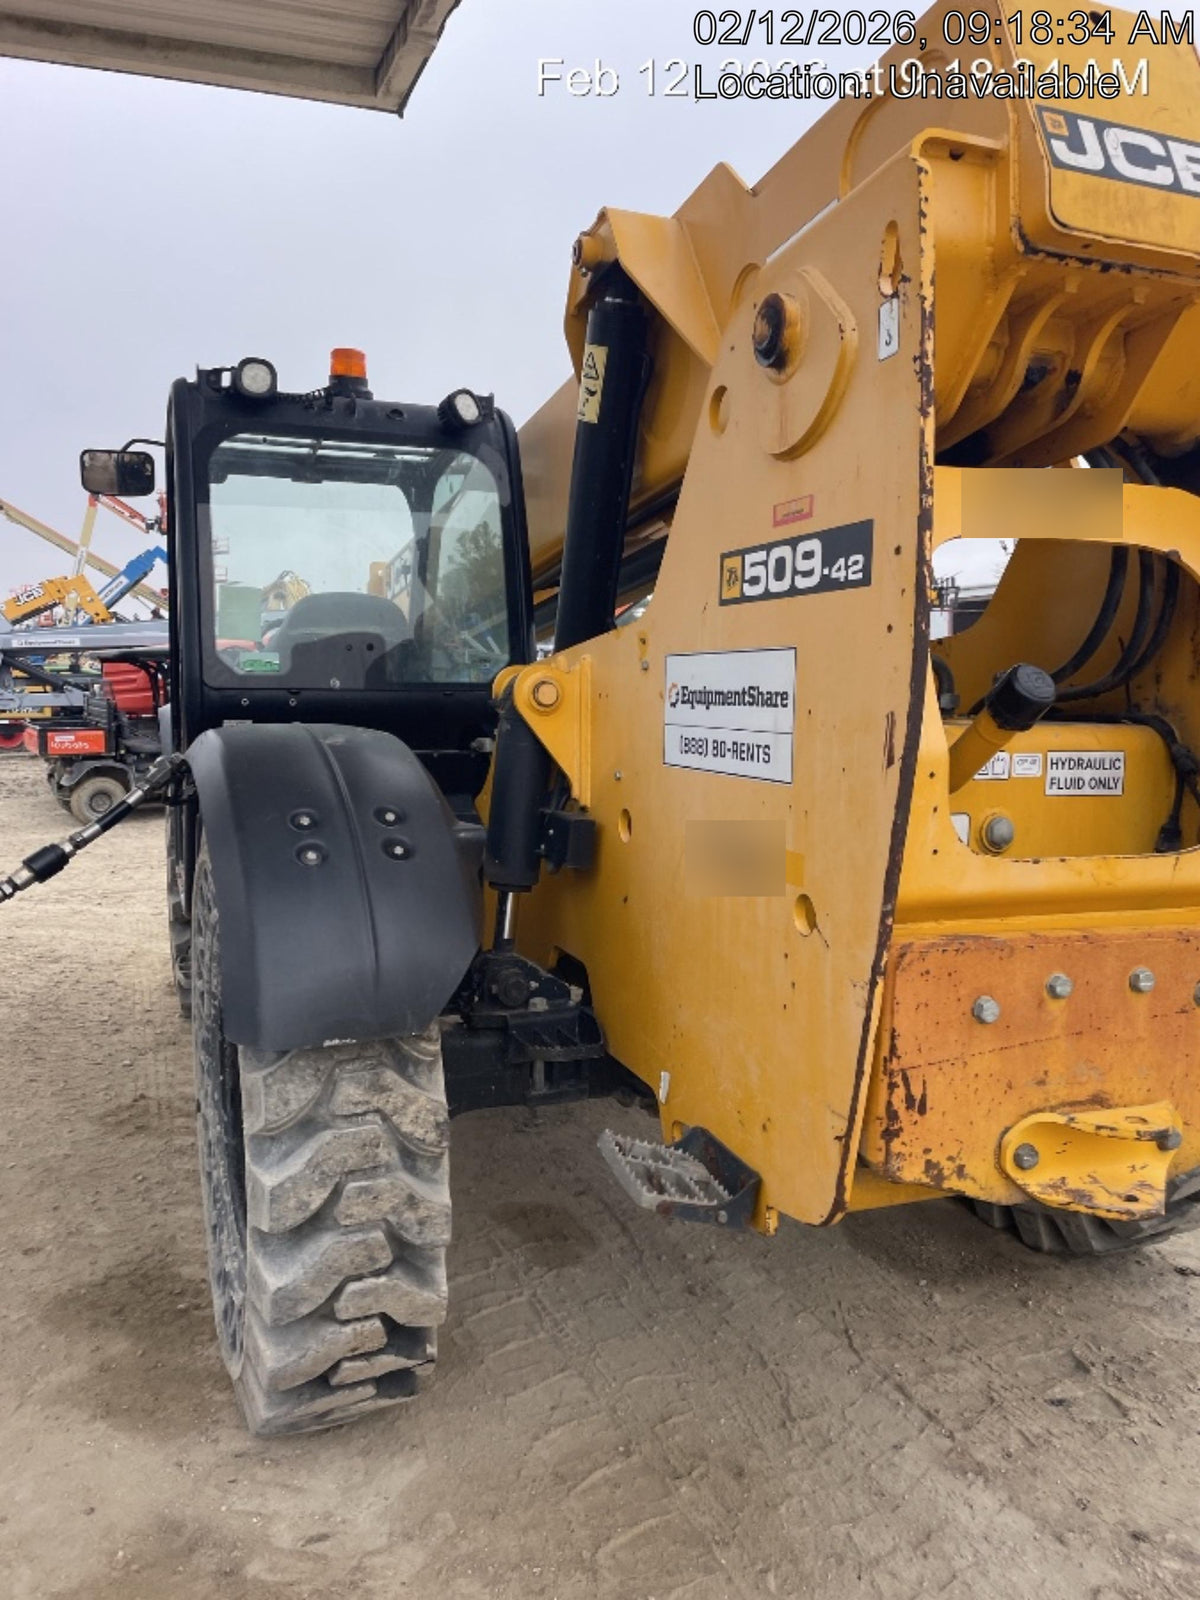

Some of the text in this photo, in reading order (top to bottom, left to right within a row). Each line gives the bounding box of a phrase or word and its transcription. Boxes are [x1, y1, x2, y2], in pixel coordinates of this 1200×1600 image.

[680, 686, 788, 710] EquipmentShare
[680, 734, 708, 758] (888)
[1050, 757, 1121, 771] HYDRAULIC
[1049, 776, 1120, 790] FLUID ONLY
